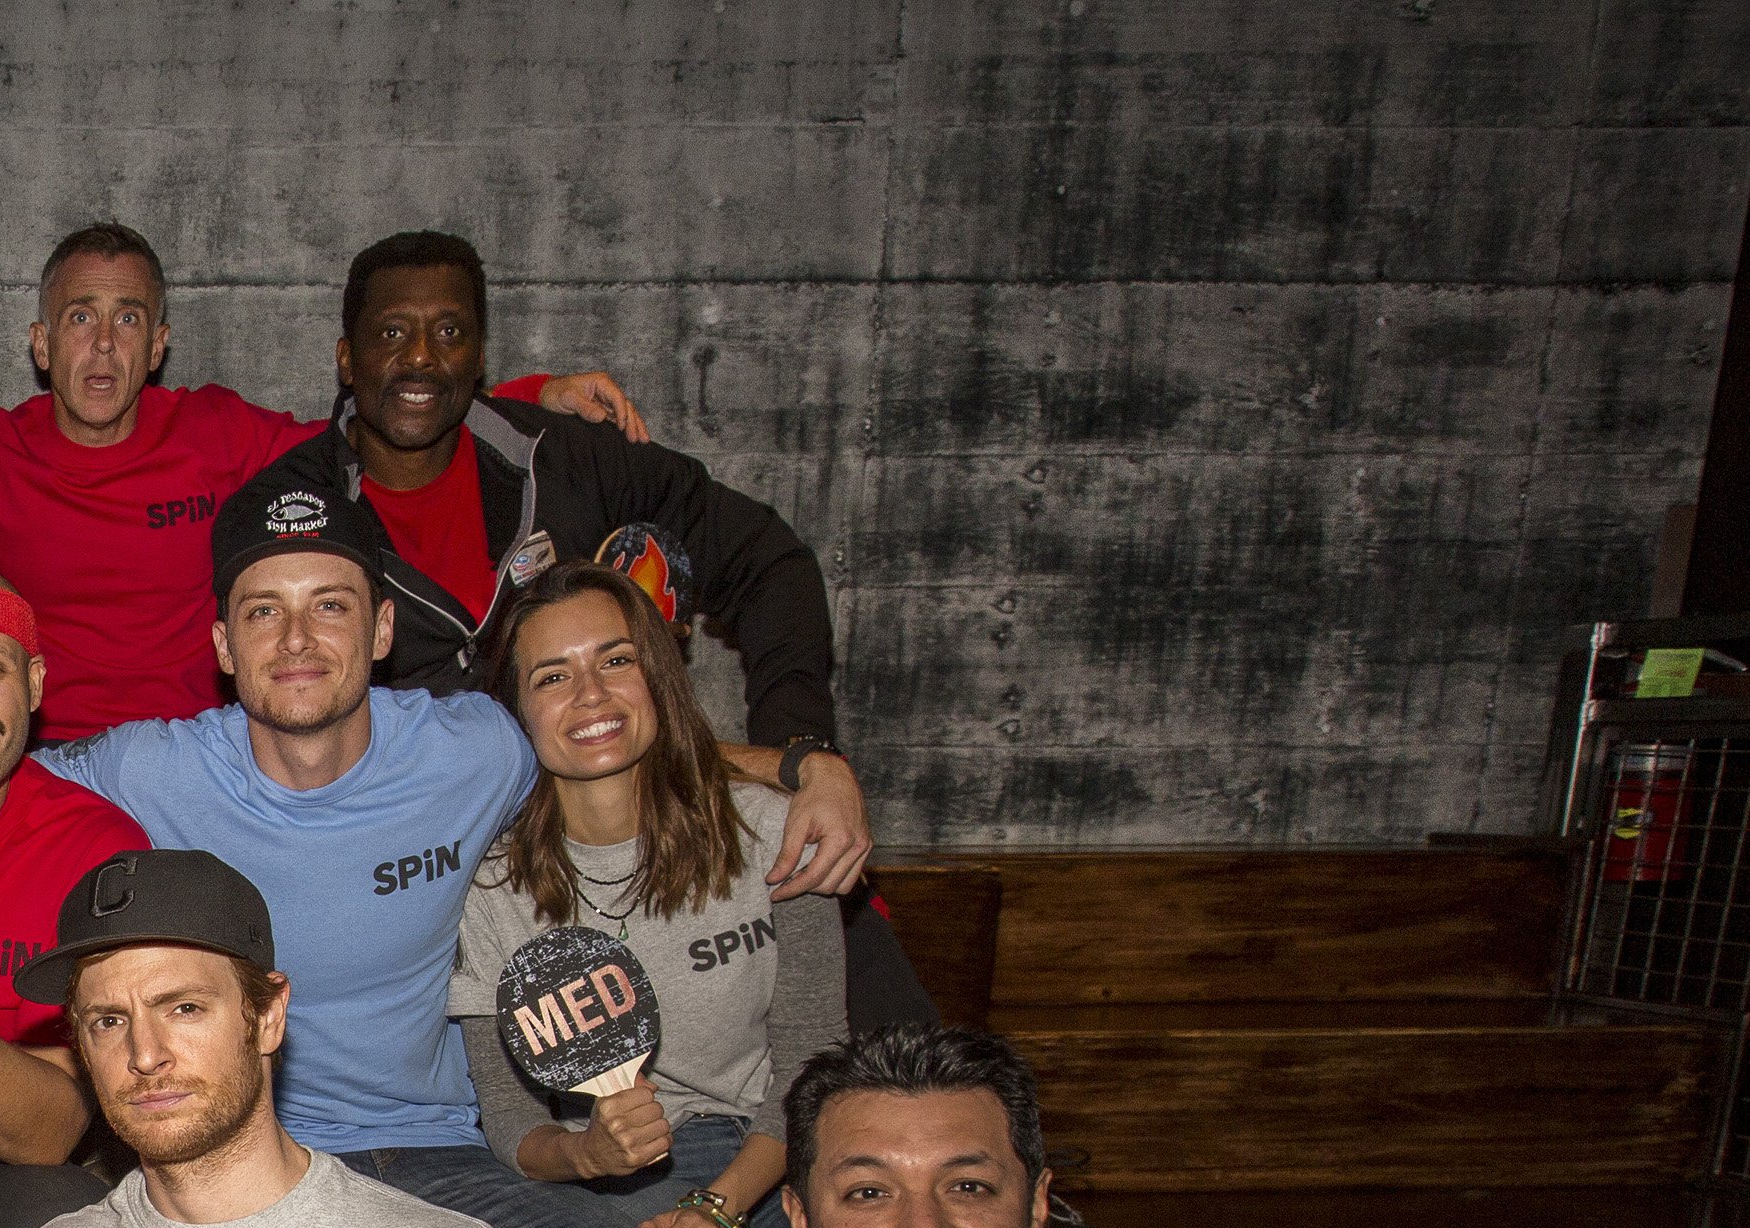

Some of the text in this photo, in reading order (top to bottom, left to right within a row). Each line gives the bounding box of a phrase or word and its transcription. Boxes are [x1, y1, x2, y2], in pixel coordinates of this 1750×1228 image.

[146, 491, 216, 529] SPiN
[89, 857, 139, 918] C
[373, 839, 462, 896] SPiN
[688, 913, 777, 972] SPiN
[513, 963, 636, 1056] MED
